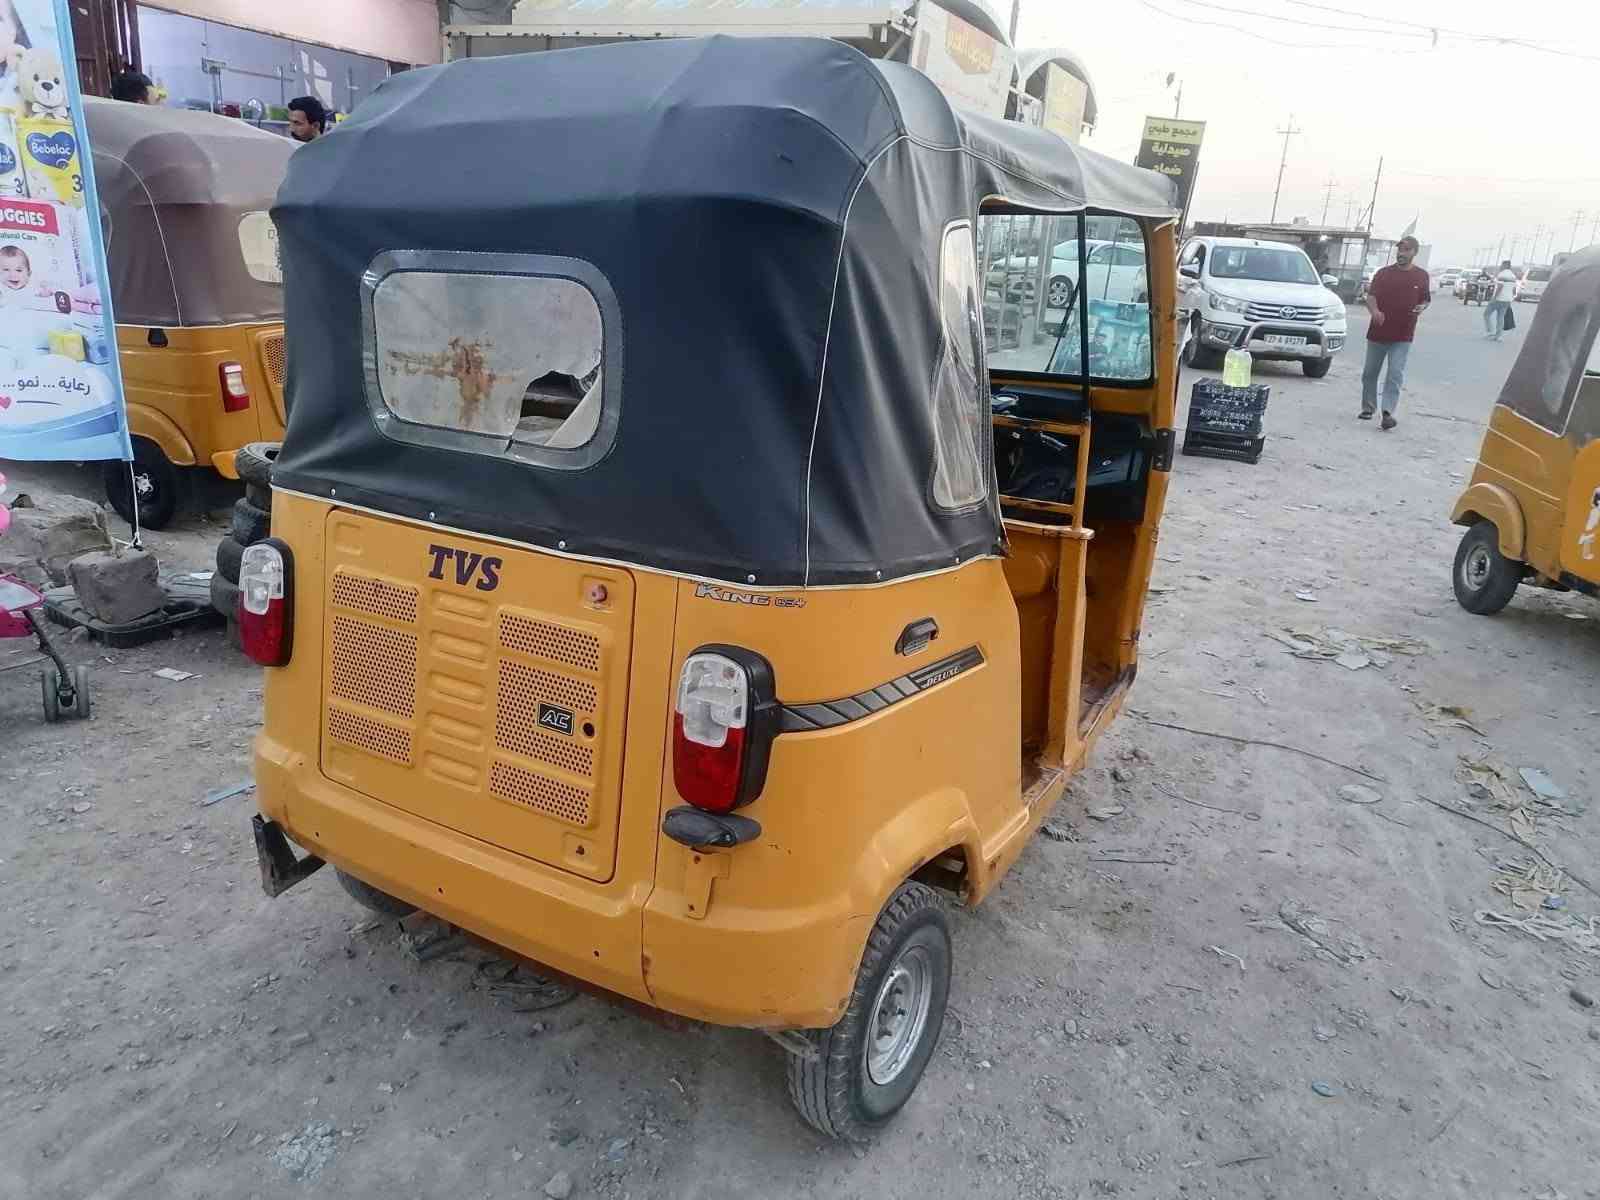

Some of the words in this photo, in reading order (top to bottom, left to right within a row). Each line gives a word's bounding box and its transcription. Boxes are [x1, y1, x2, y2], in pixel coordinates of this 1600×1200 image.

[31, 143, 71, 155] Bebelac
[71, 174, 83, 192] 3
[428, 544, 503, 591] TVS
[695, 582, 769, 606] KING
[925, 665, 961, 687] DELUXE
